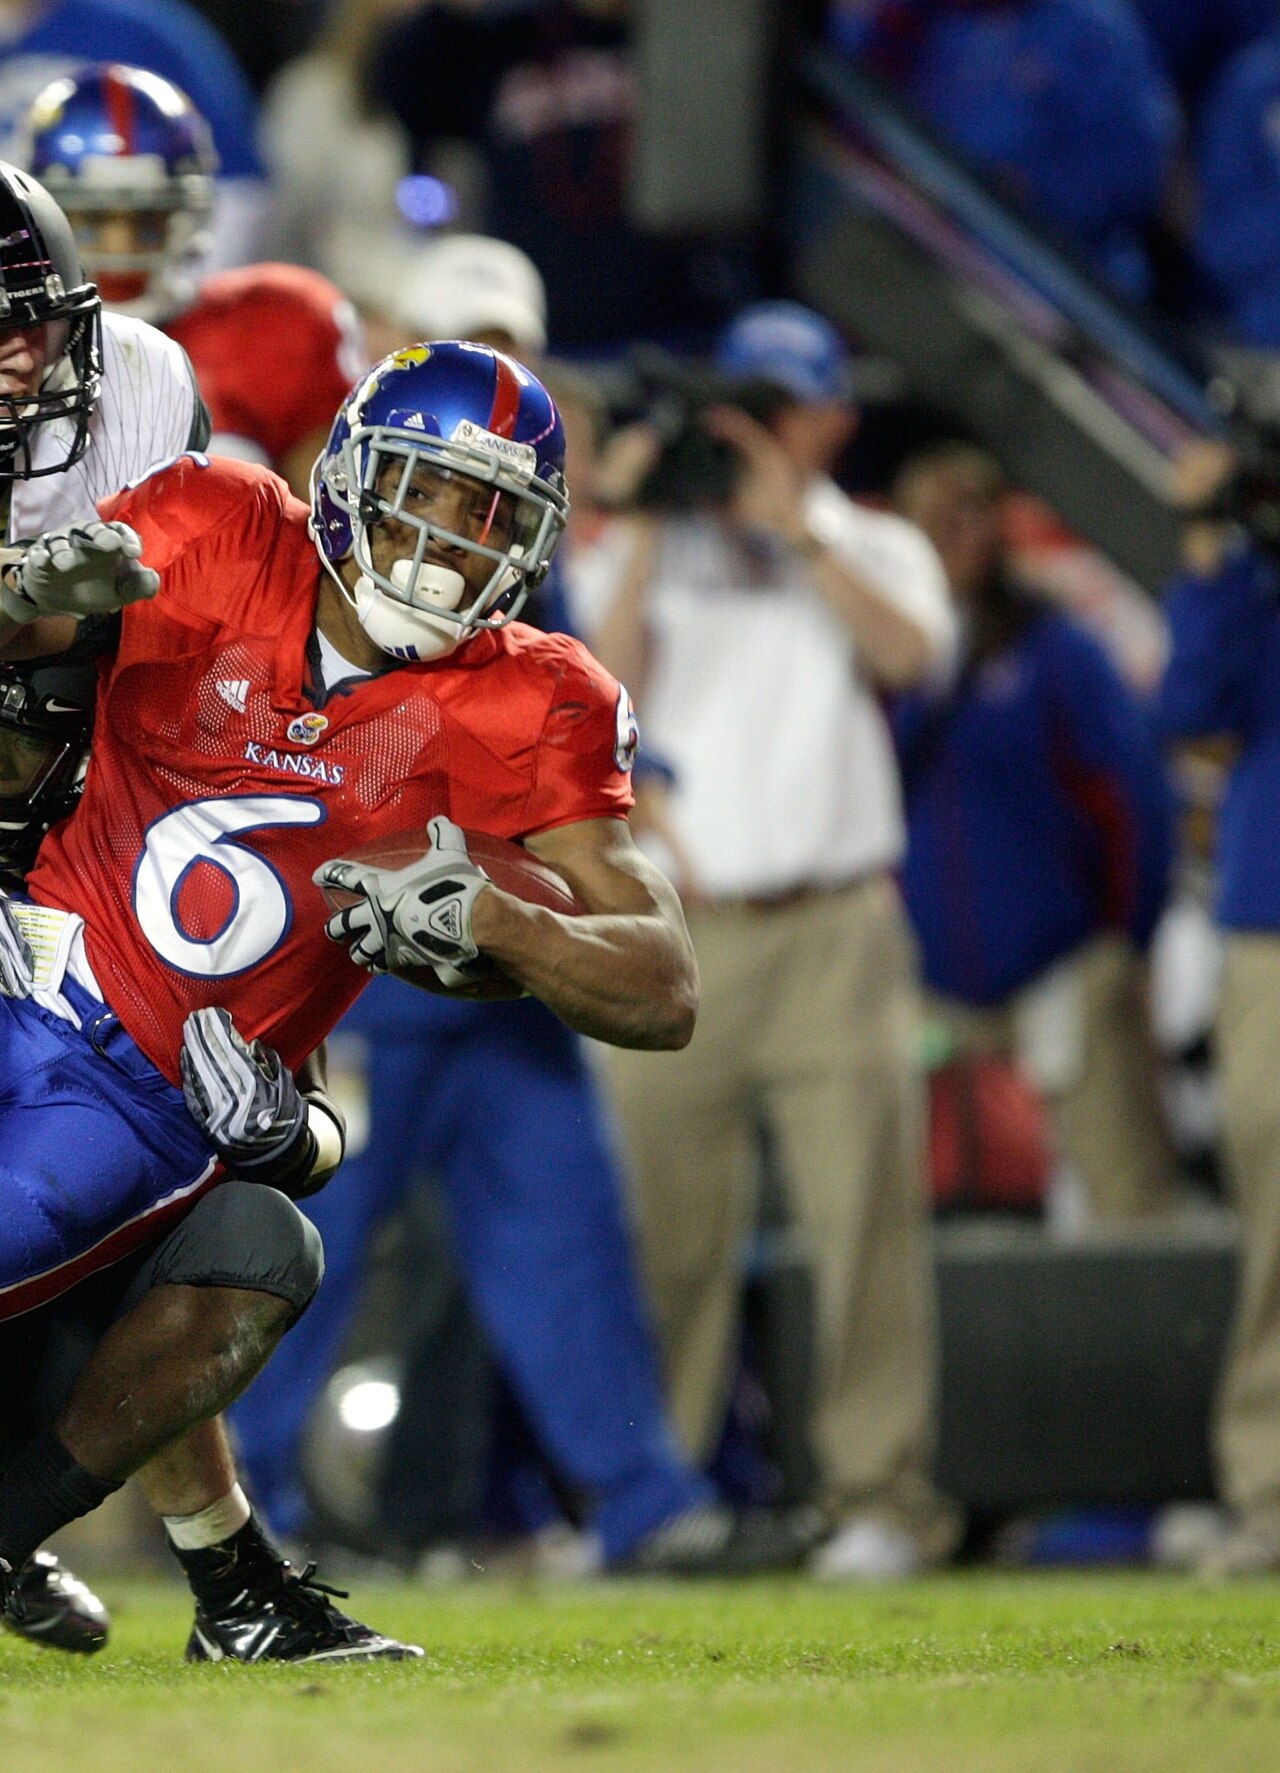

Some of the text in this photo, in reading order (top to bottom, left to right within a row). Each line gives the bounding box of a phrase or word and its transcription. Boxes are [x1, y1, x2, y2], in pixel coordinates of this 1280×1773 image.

[7, 286, 45, 299] TIGERS
[244, 741, 344, 784] KANSAS
[130, 793, 327, 980] 6
